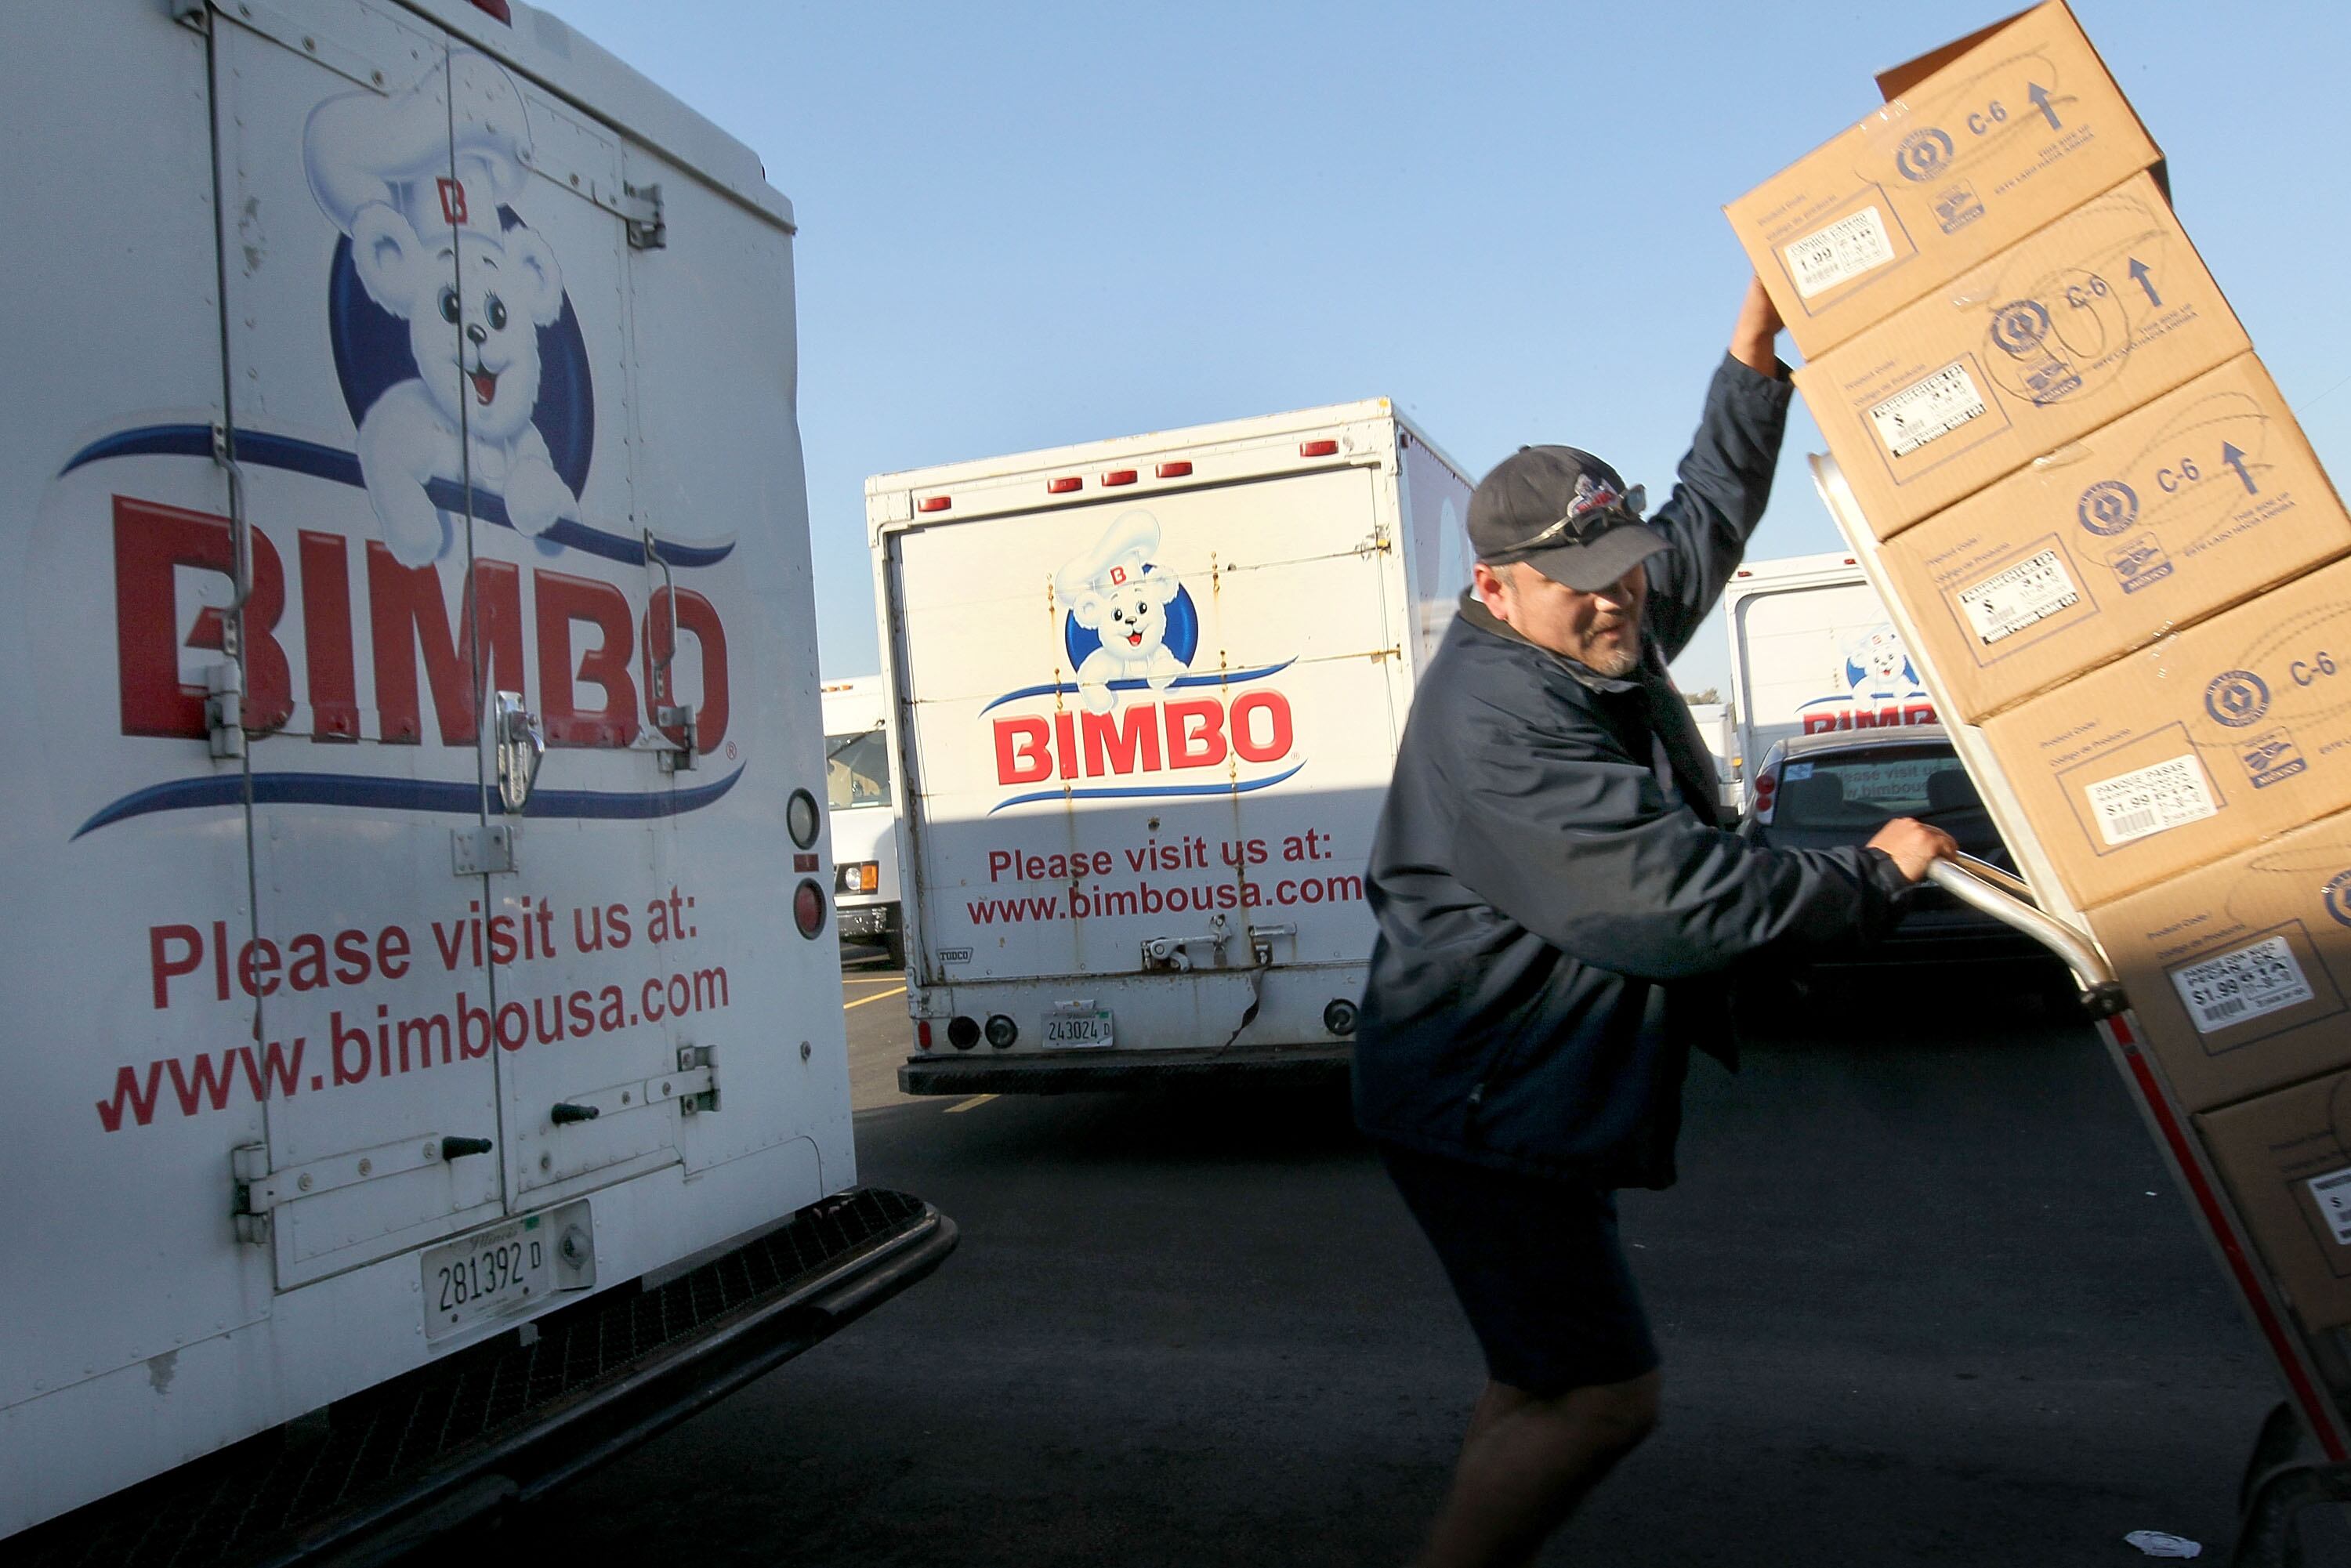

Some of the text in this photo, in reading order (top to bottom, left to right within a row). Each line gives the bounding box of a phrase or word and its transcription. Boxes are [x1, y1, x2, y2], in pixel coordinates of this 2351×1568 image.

[1967, 100, 2007, 136] C-6
[2067, 275, 2107, 310] C-6
[2157, 457, 2201, 494] C-6
[1110, 565, 1127, 586] B
[112, 494, 730, 756] BIMBO
[2290, 651, 2336, 686] C-6
[993, 688, 1293, 785] BIMBO
[988, 827, 1332, 882] Please visit us at:
[966, 871, 1363, 925] www.bimbousa.com
[150, 884, 698, 1009] Please visit us at:
[940, 951, 969, 961] TODCO
[2191, 976, 2241, 1007] $1.99
[96, 965, 730, 1132] www.bimbousa.com
[1049, 1021, 1110, 1041] 243024 D
[439, 1242, 523, 1312] 281392
